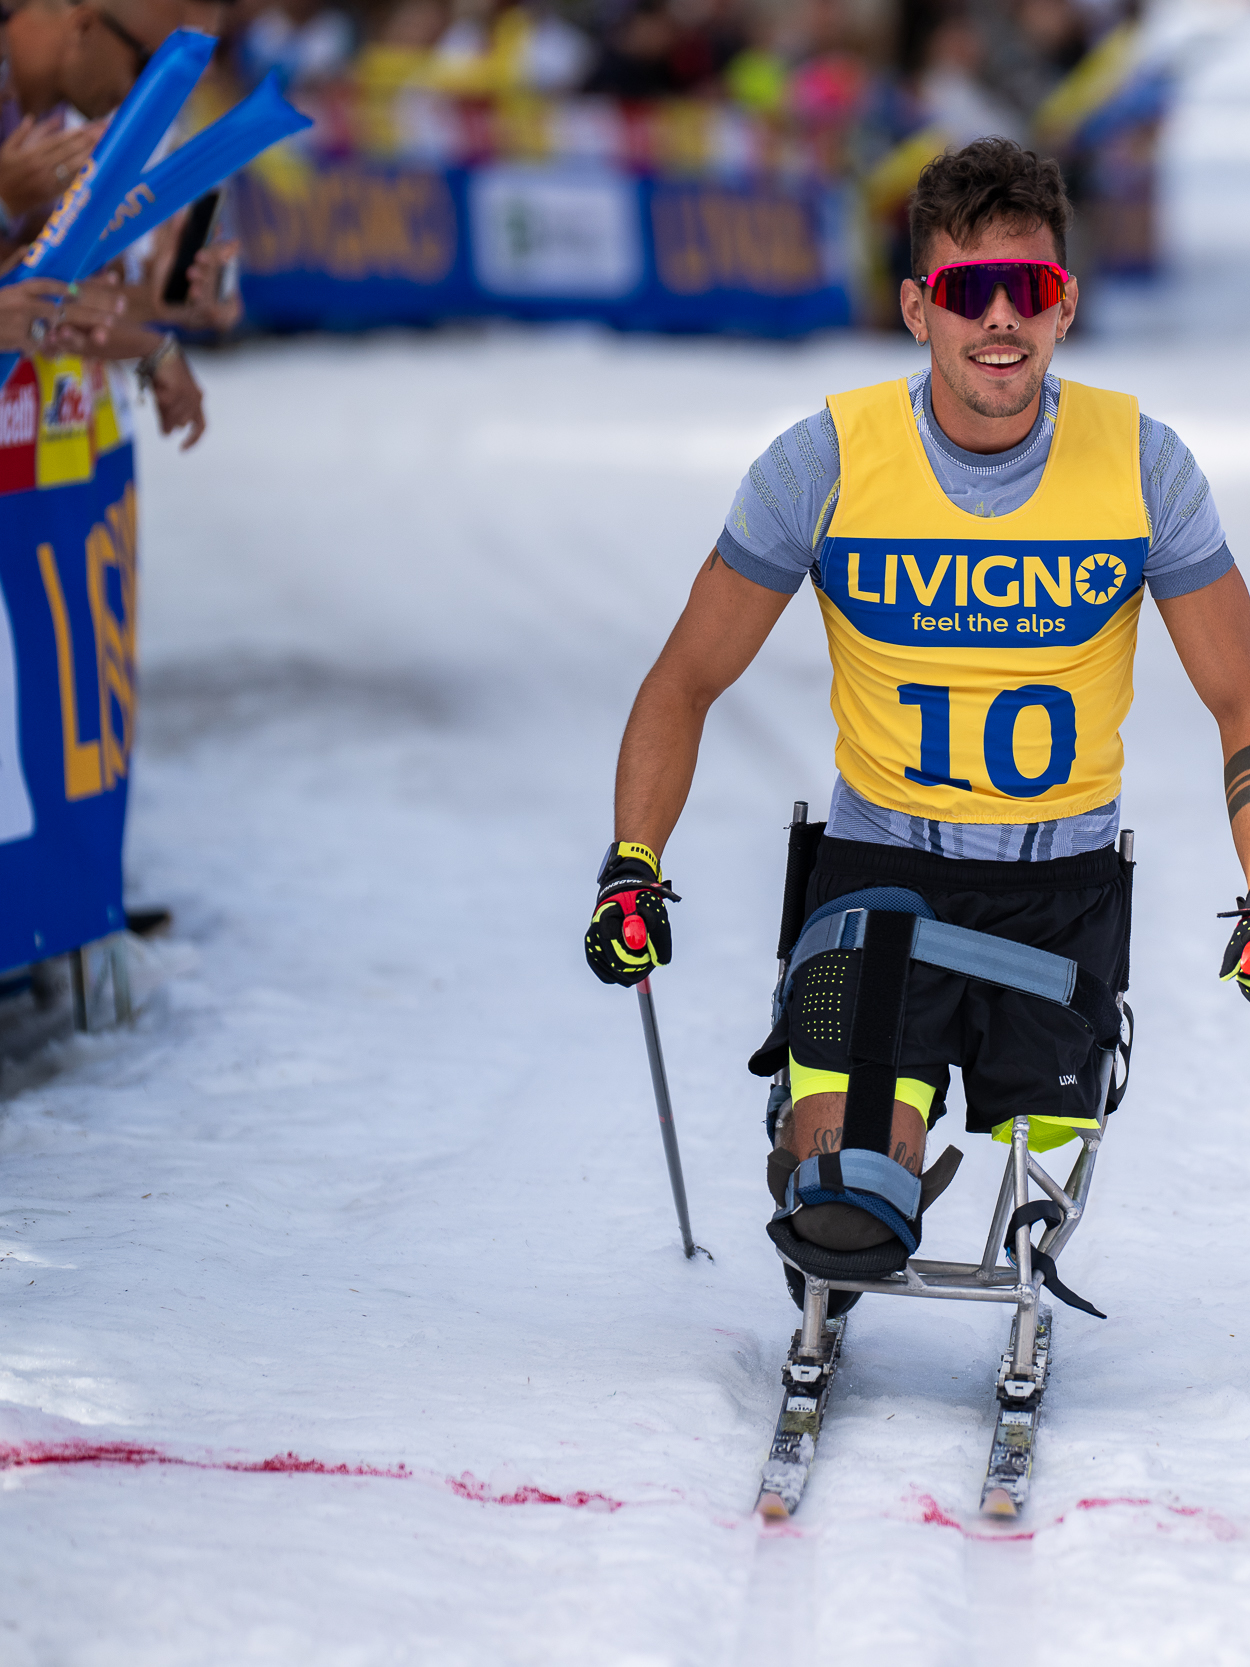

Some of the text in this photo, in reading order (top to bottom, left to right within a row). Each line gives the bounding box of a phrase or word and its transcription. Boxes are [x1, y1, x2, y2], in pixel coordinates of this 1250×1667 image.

[847, 552, 1127, 608] LIVIGNO
[912, 612, 1066, 638] feel the alps
[896, 682, 1078, 799] 10
